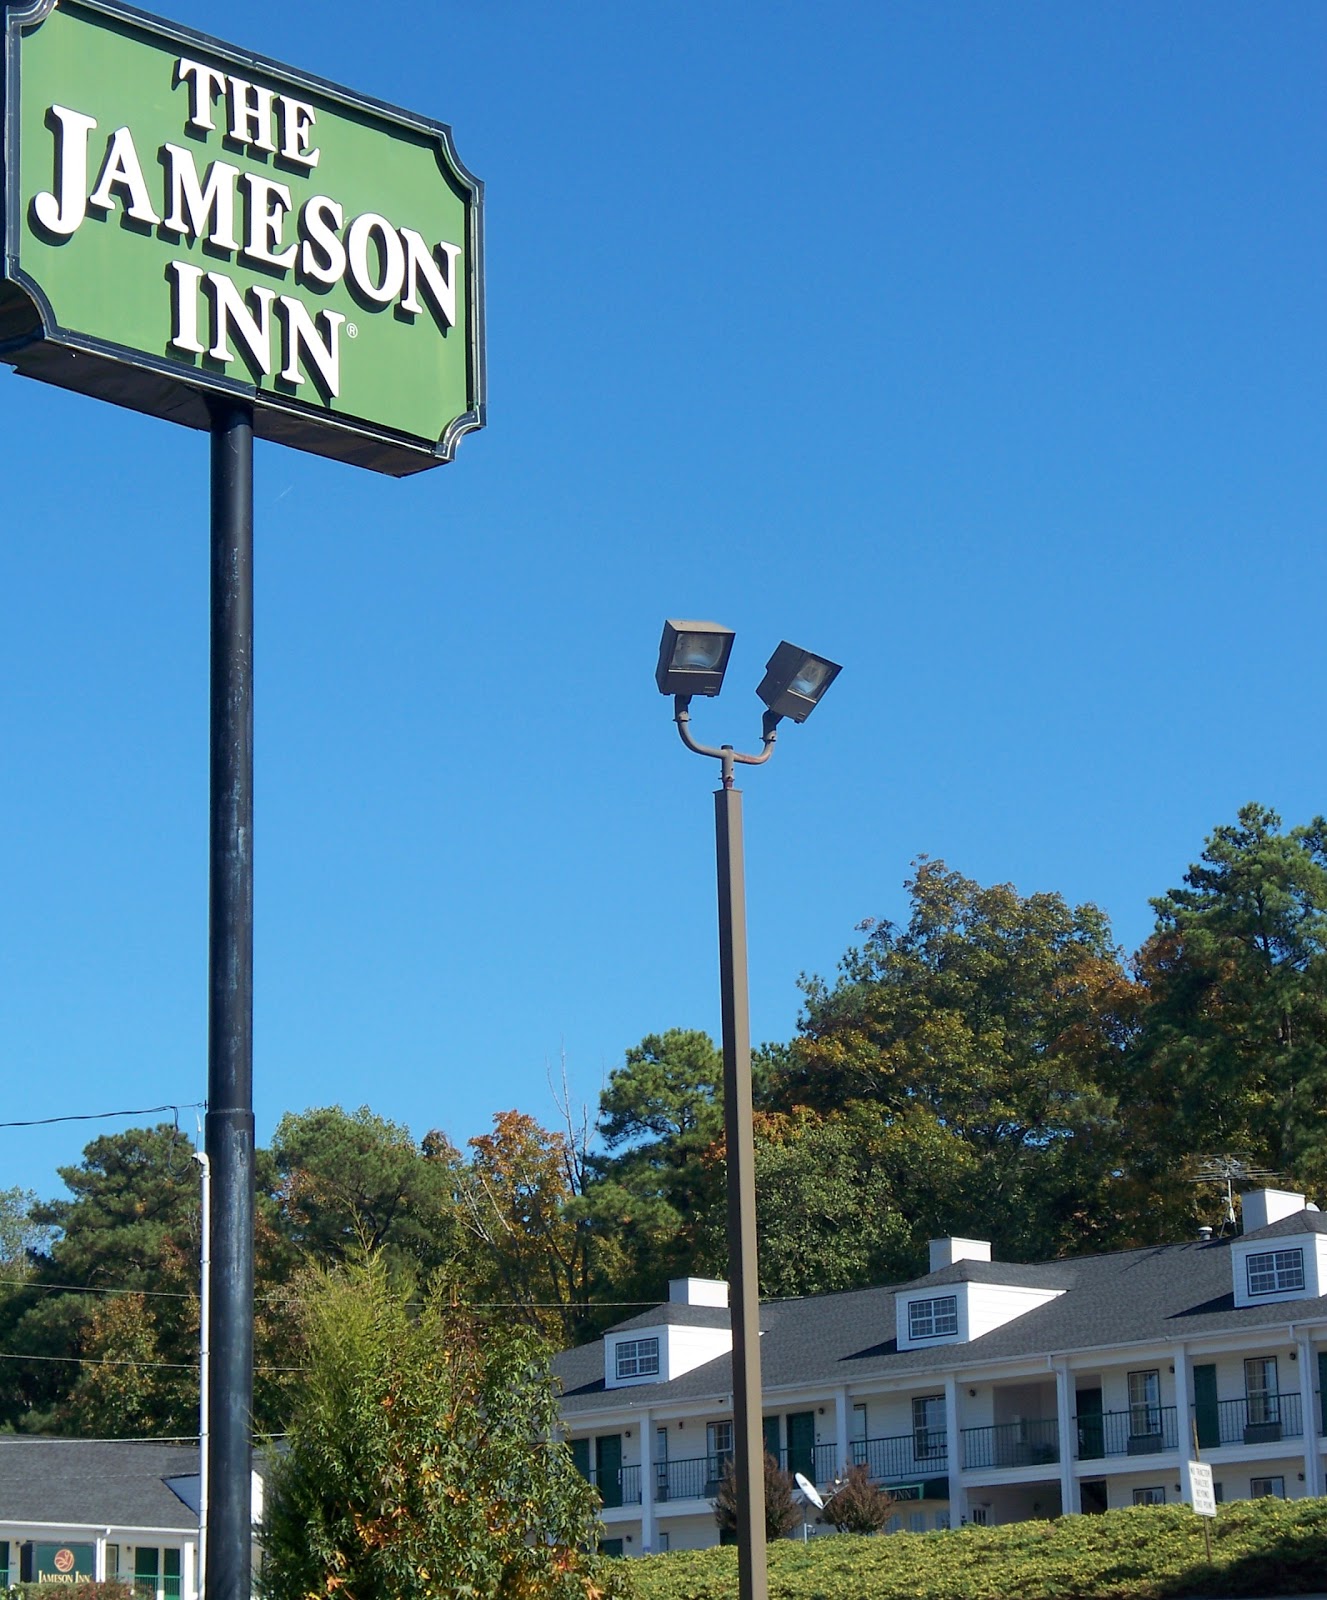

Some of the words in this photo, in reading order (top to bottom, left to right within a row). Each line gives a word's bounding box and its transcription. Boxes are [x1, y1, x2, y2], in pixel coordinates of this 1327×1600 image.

[178, 57, 320, 168] THE
[34, 104, 462, 328] JAMESON
[38, 1569, 73, 1584] JAMESON
[75, 1570, 91, 1584] INN
